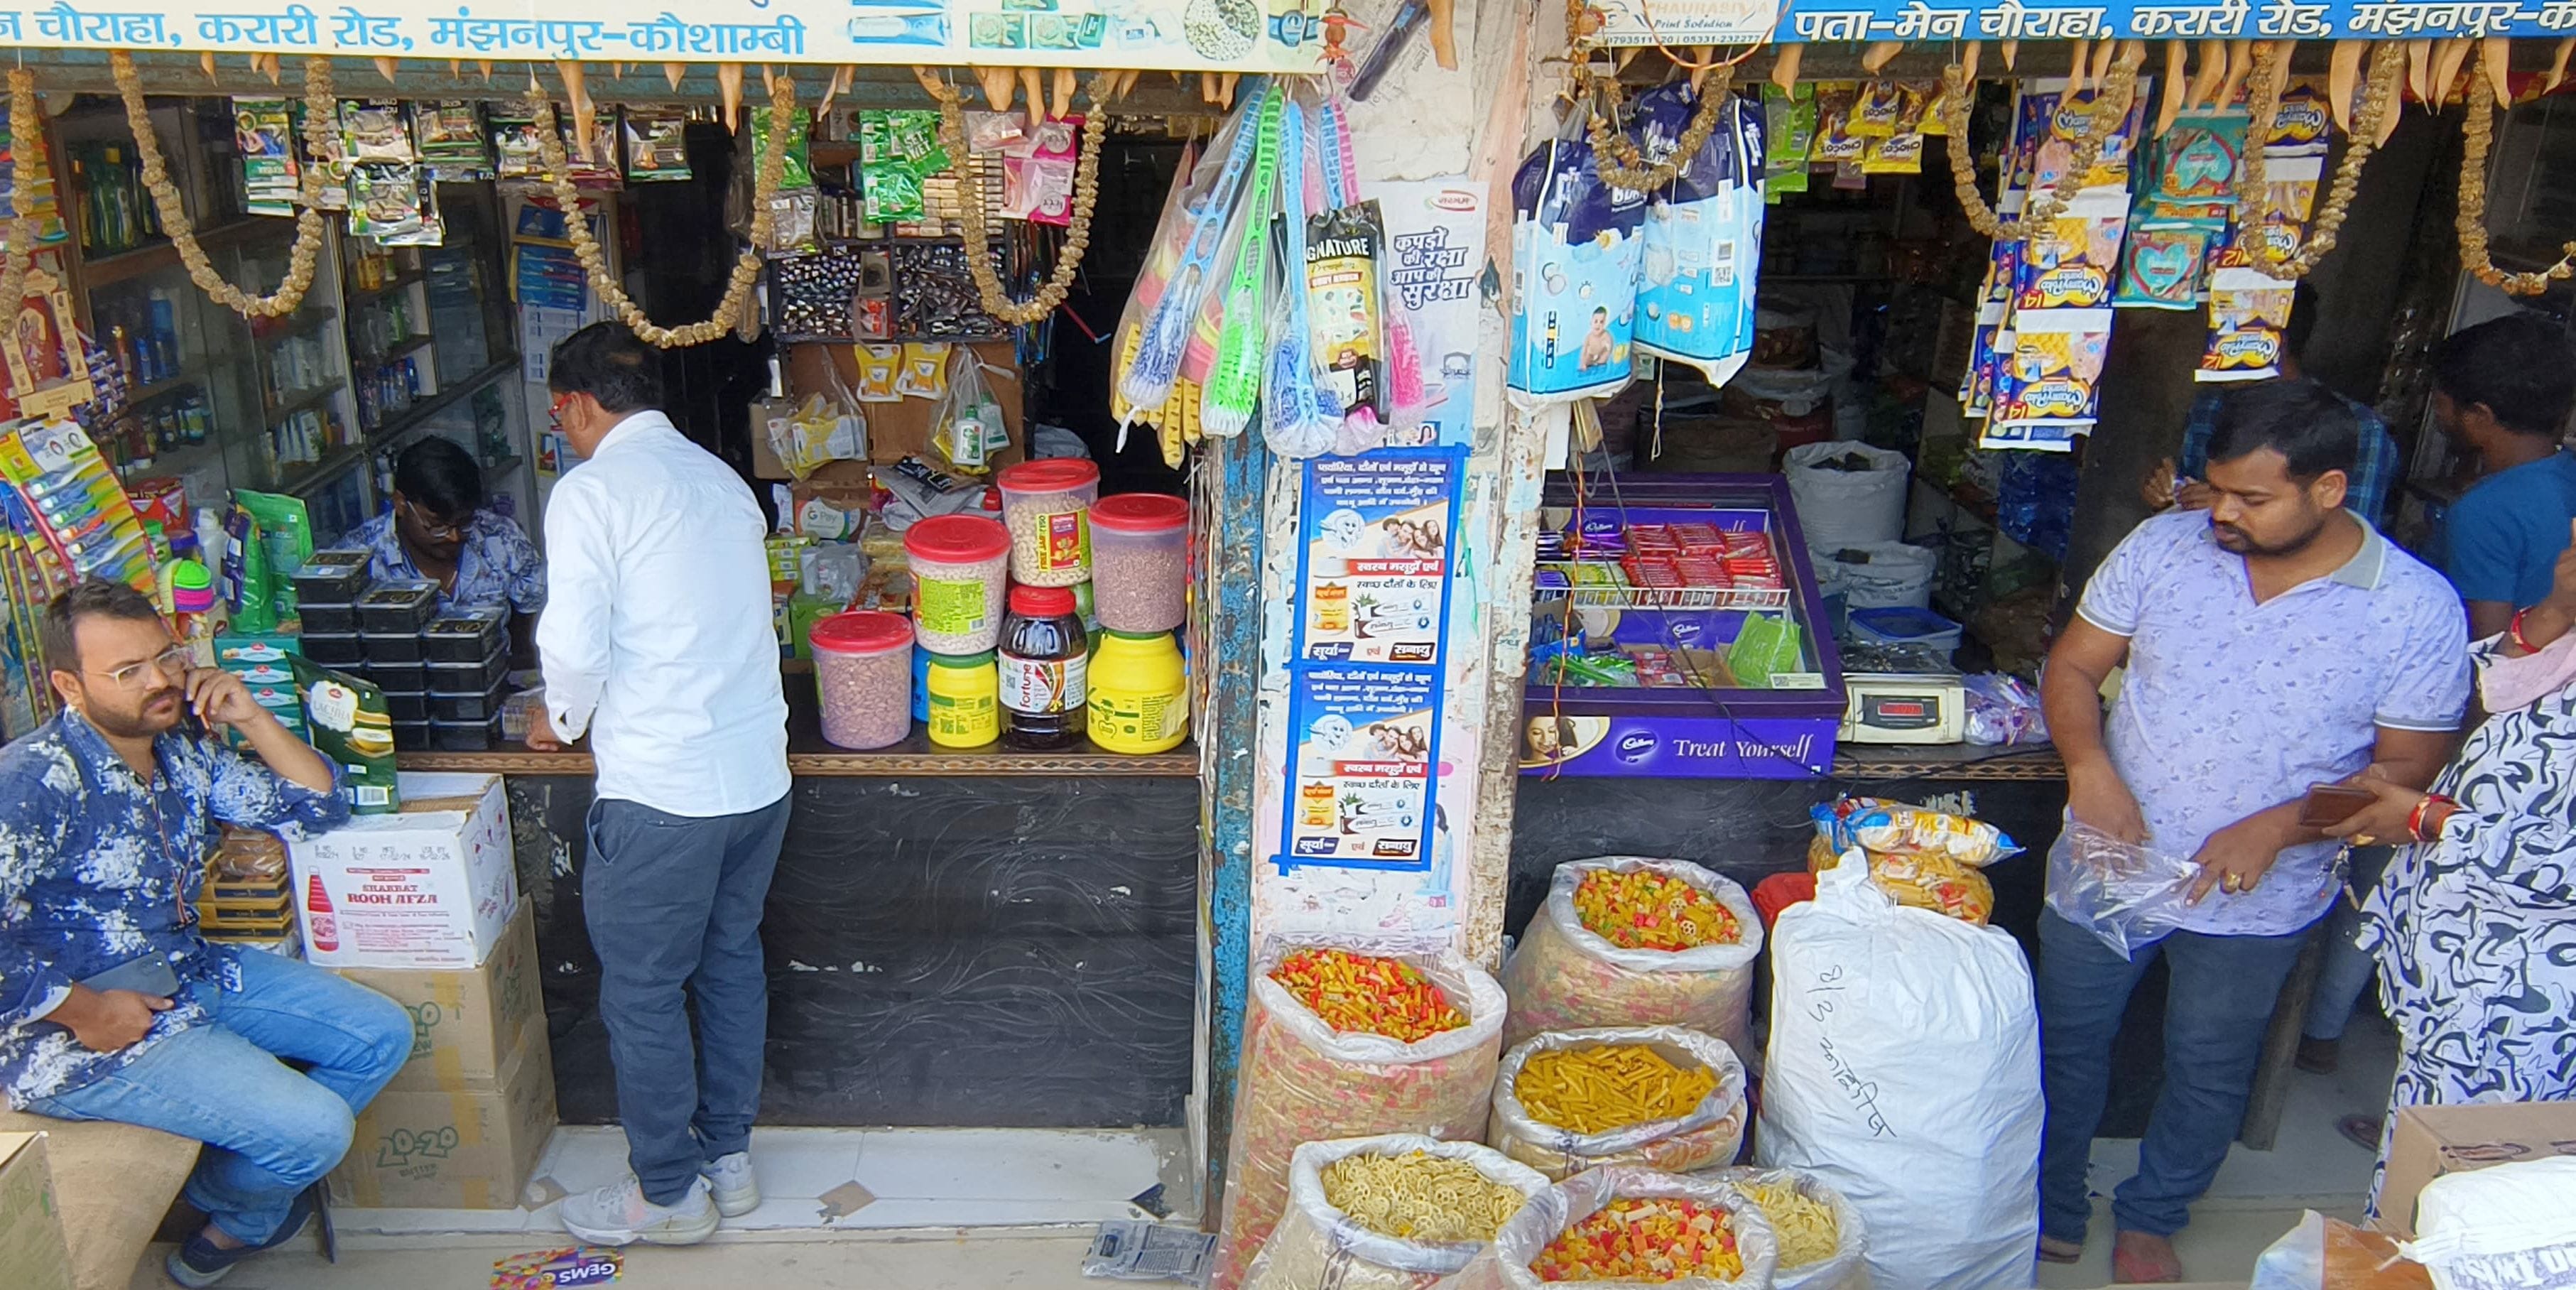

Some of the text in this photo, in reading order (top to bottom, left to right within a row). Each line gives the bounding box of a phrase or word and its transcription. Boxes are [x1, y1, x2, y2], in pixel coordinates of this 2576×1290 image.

[1653, 18, 1733, 29] Print Solution
[1794, 1, 1971, 40] पता-मेन
[1979, 0, 2112, 38] चौराहा,
[2131, 0, 2251, 36] करारी
[2258, 0, 2332, 38] रोड,
[36, 1, 181, 47] चौराहा,
[195, 4, 319, 44] करारी
[330, 6, 415, 50] रोड,
[428, 6, 807, 60] मंझनपुर-कौशाम्बी
[1395, 227, 1449, 253] कपड़ों
[1403, 246, 1469, 269] की रक्षा
[2222, 249, 2243, 266] 12
[1391, 266, 1444, 285] आप की
[1401, 277, 1476, 310] सुरक्षा
[2023, 292, 2043, 308] 14
[2203, 354, 2222, 369] 12
[2009, 403, 2027, 418] 14
[1406, 579, 1417, 588] के
[1419, 579, 1438, 590] लिए
[1019, 663, 1032, 708] fortune
[1673, 739, 1727, 758] Treat
[1736, 734, 1815, 764] Yourself
[1403, 779, 1420, 790] लिए
[347, 893, 438, 904] ROOH AFZA
[376, 1126, 459, 1169] 20-20
[559, 1262, 616, 1283] GEMS
